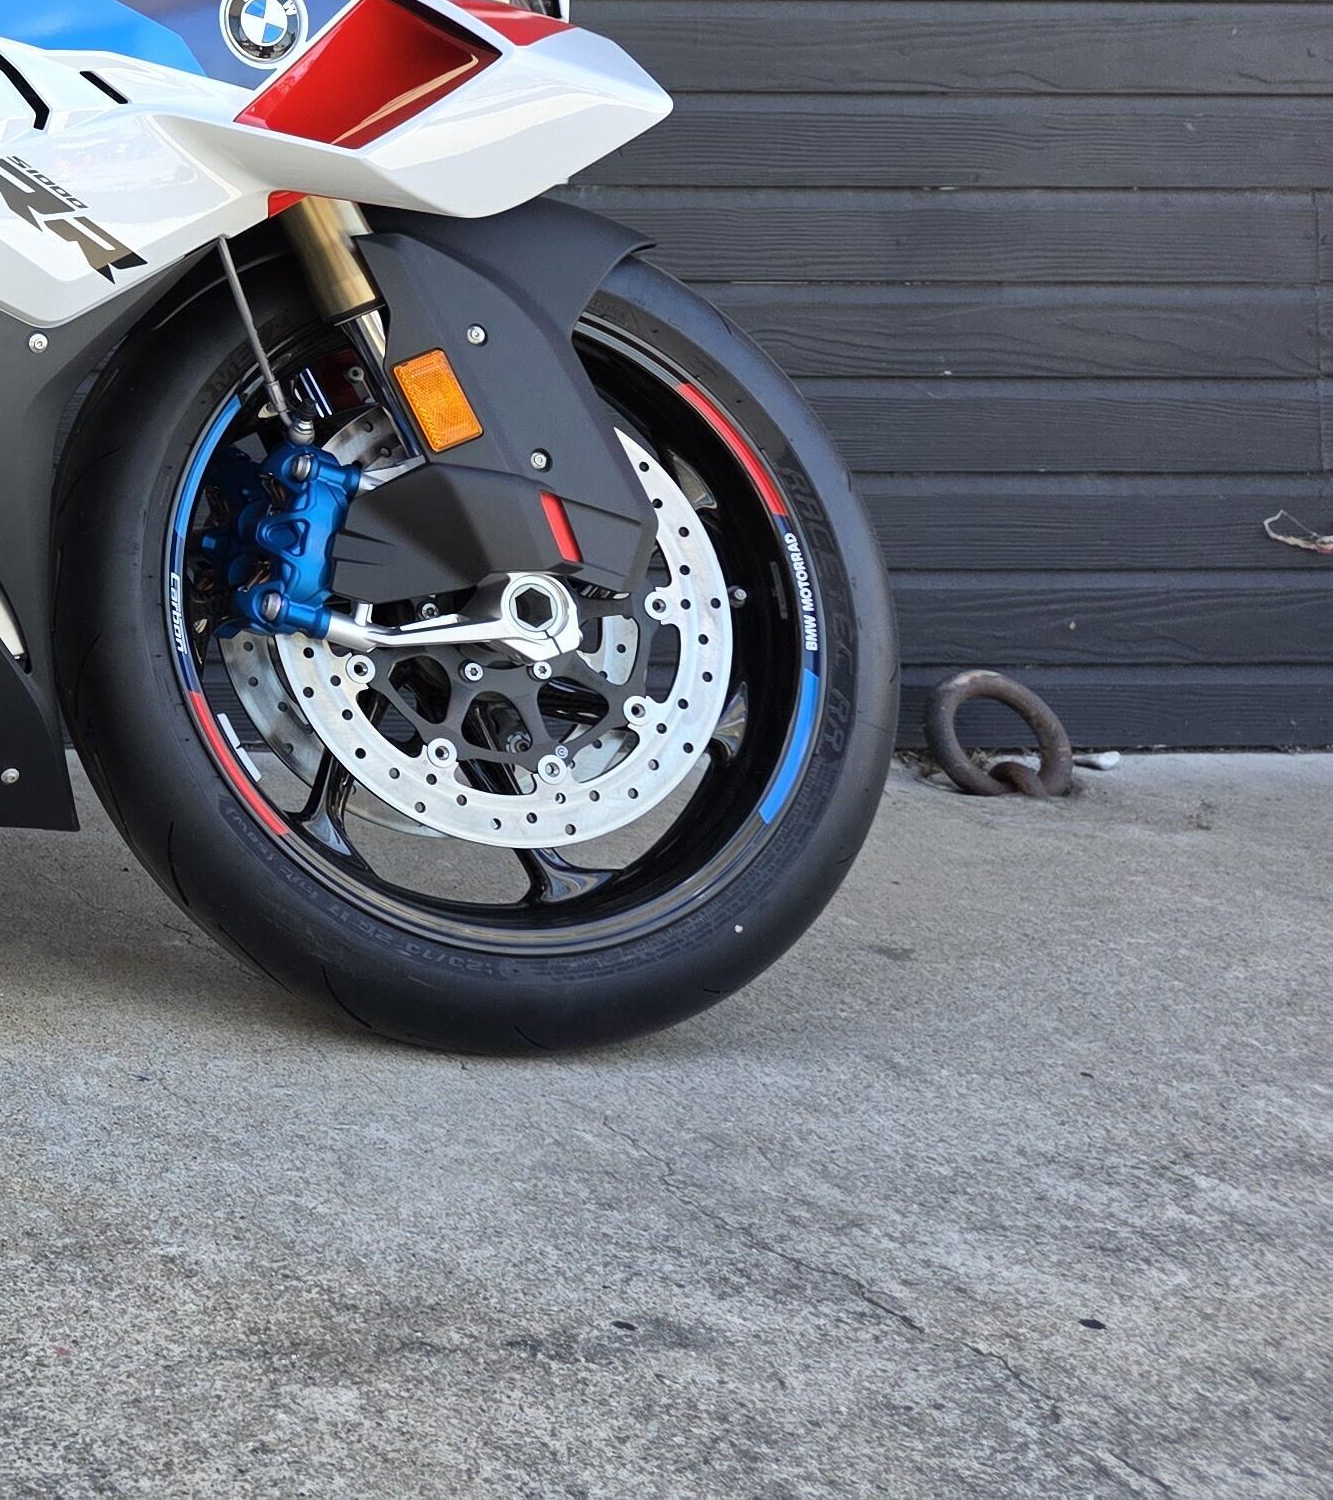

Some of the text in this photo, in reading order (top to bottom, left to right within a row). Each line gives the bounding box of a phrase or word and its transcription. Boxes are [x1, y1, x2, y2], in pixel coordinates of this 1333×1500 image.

[171, 572, 187, 654] Carbon
[783, 532, 819, 651] BMW MOTORRAD
